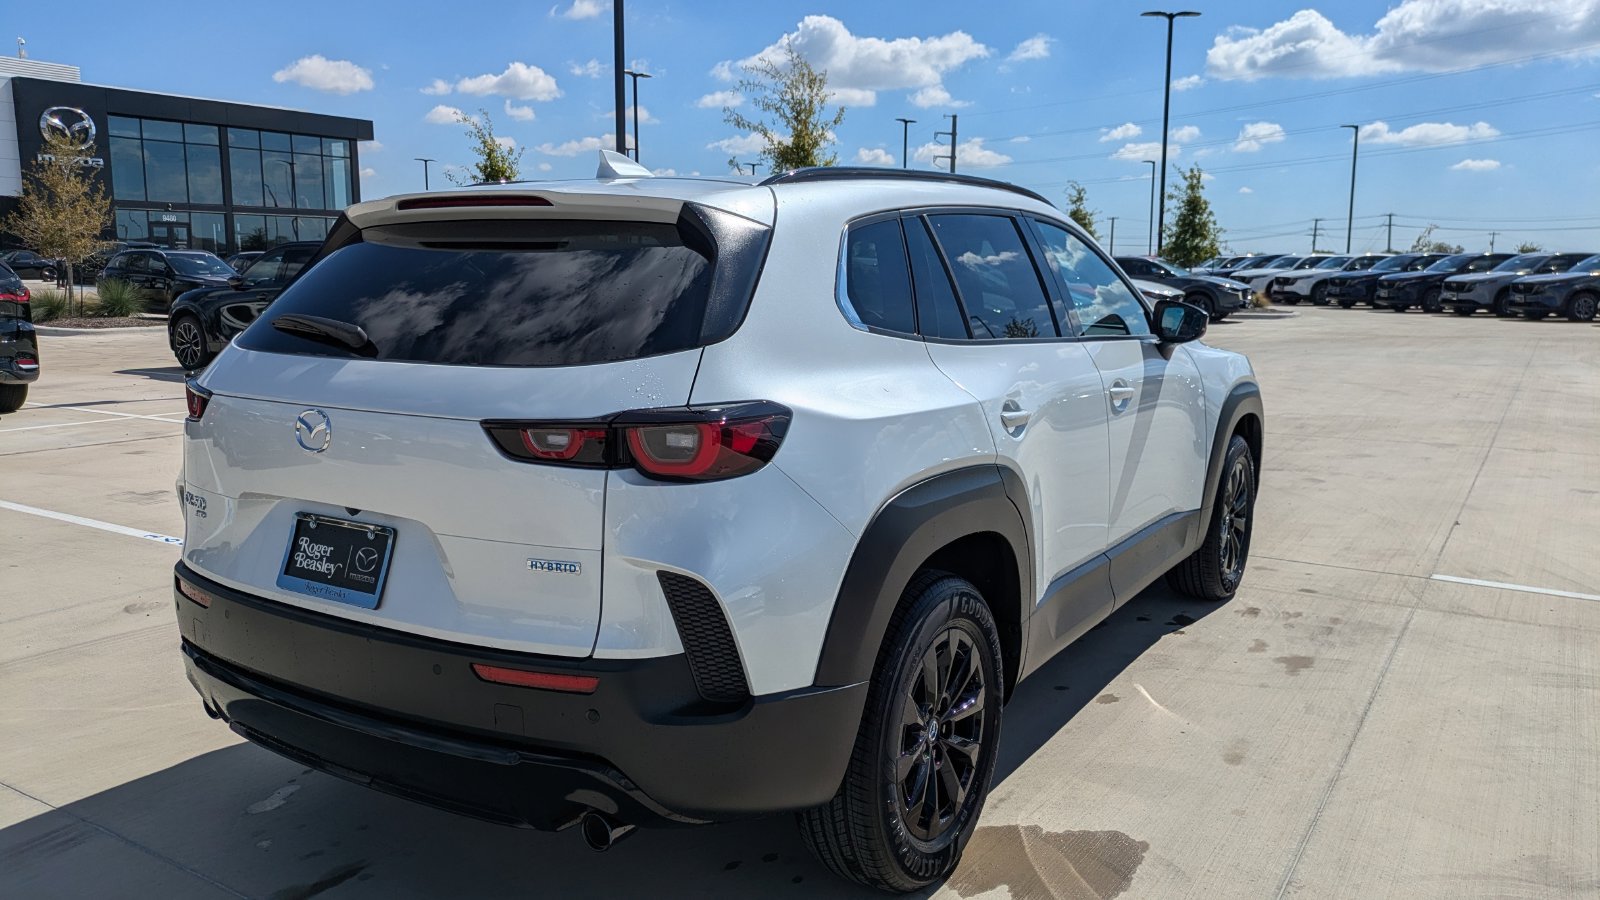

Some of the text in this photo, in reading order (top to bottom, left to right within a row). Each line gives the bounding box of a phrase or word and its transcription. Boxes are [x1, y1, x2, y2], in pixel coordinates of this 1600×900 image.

[37, 153, 104, 169] mzda
[298, 536, 334, 559] Roger
[294, 552, 343, 578] Beasley
[530, 561, 577, 573] HYBRID
[349, 572, 375, 584] mazda
